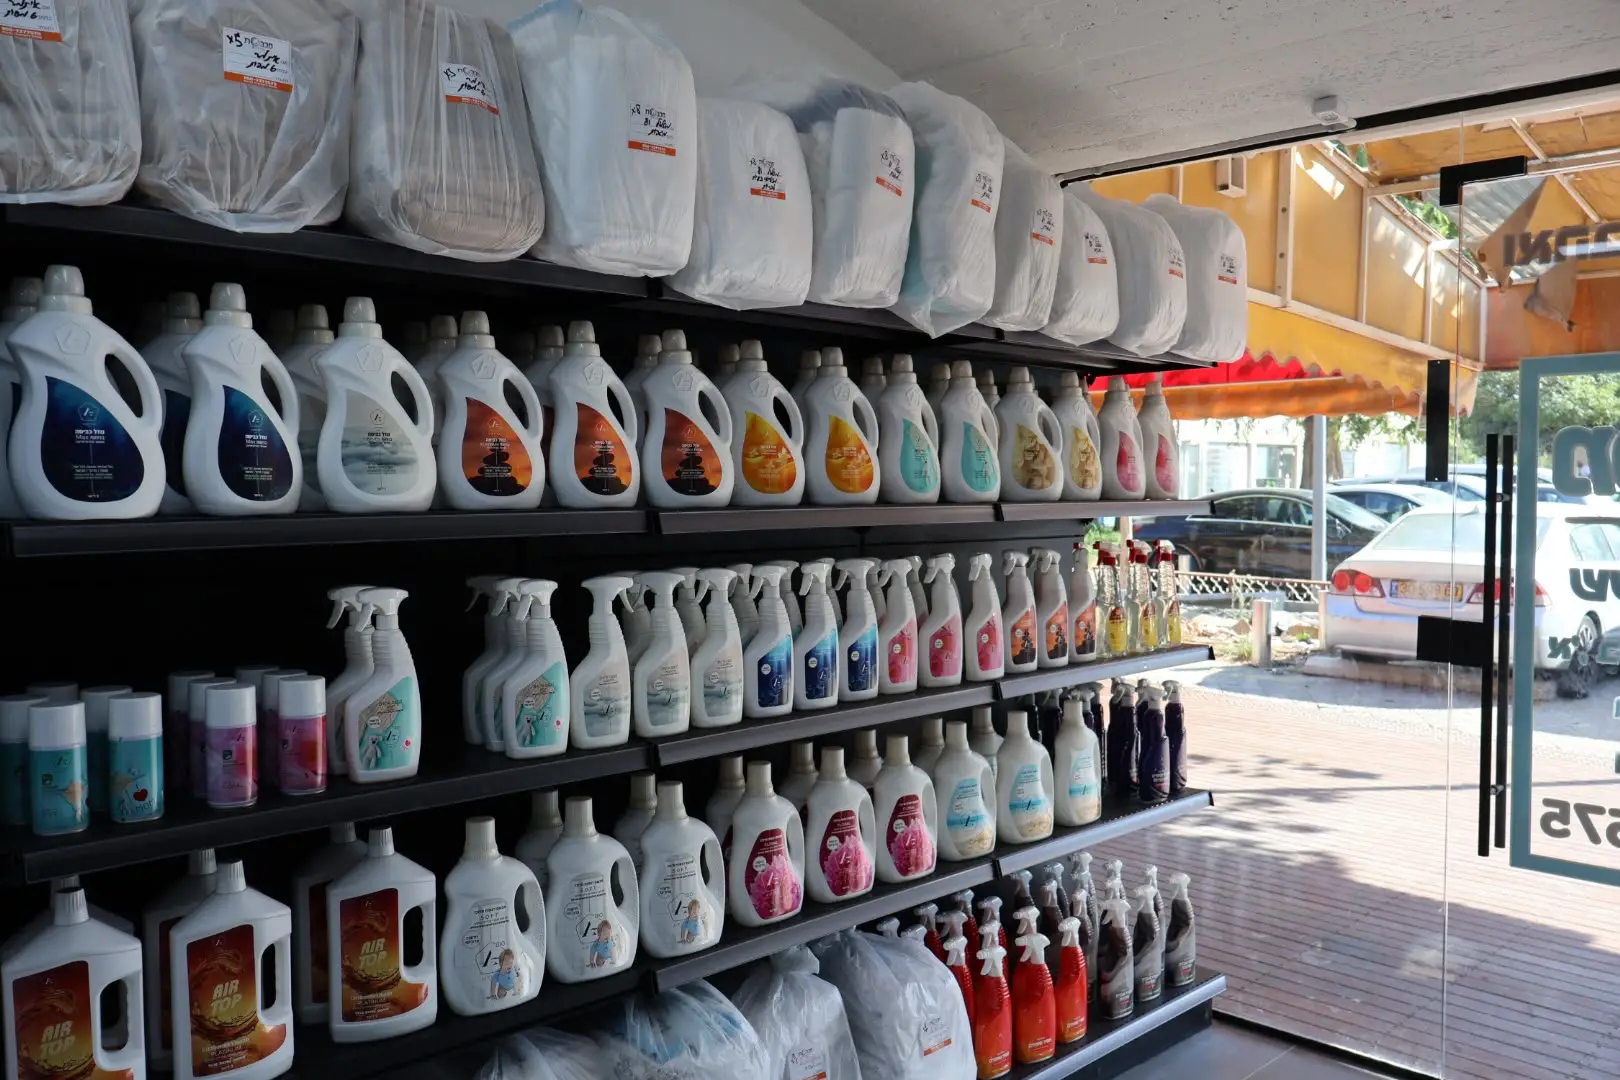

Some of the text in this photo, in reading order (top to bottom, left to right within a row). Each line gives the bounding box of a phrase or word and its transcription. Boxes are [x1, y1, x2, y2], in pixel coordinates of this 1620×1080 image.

[480, 912, 499, 920] SOFT
[361, 937, 386, 955] AIR
[359, 952, 387, 968] TOP
[213, 979, 240, 1000] AIR
[211, 993, 242, 1015] TOP
[41, 1020, 73, 1043] AIR
[39, 1036, 75, 1056] TOP
